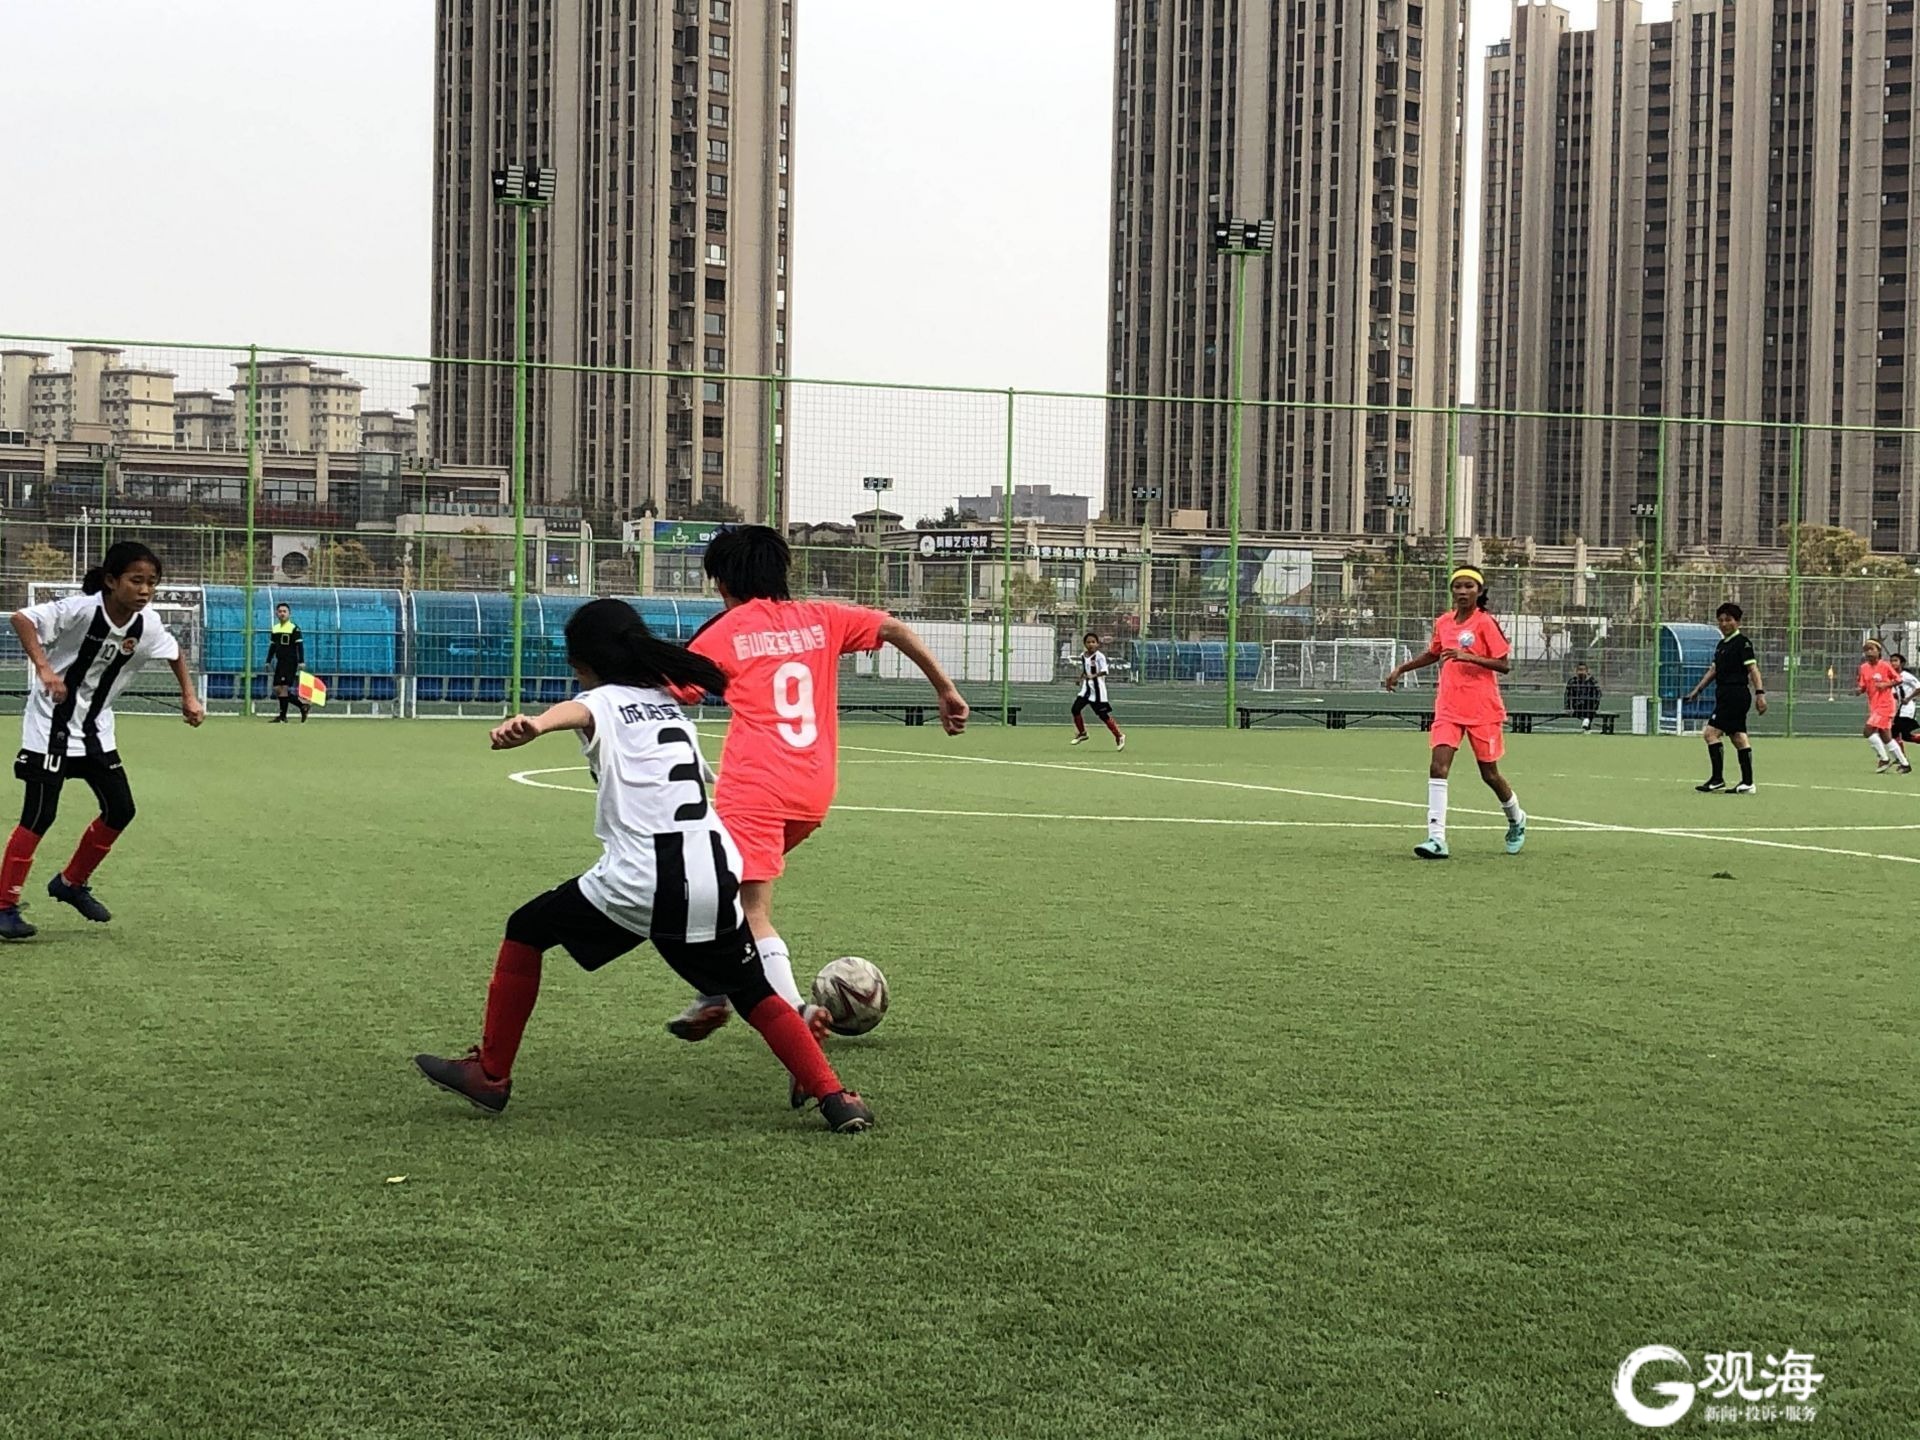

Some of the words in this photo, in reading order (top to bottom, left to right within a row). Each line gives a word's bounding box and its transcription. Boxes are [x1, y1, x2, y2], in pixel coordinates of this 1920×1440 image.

[100, 644, 116, 660] 10
[618, 702, 690, 724] 城阳实
[773, 662, 817, 748] 9
[658, 727, 708, 821] 3
